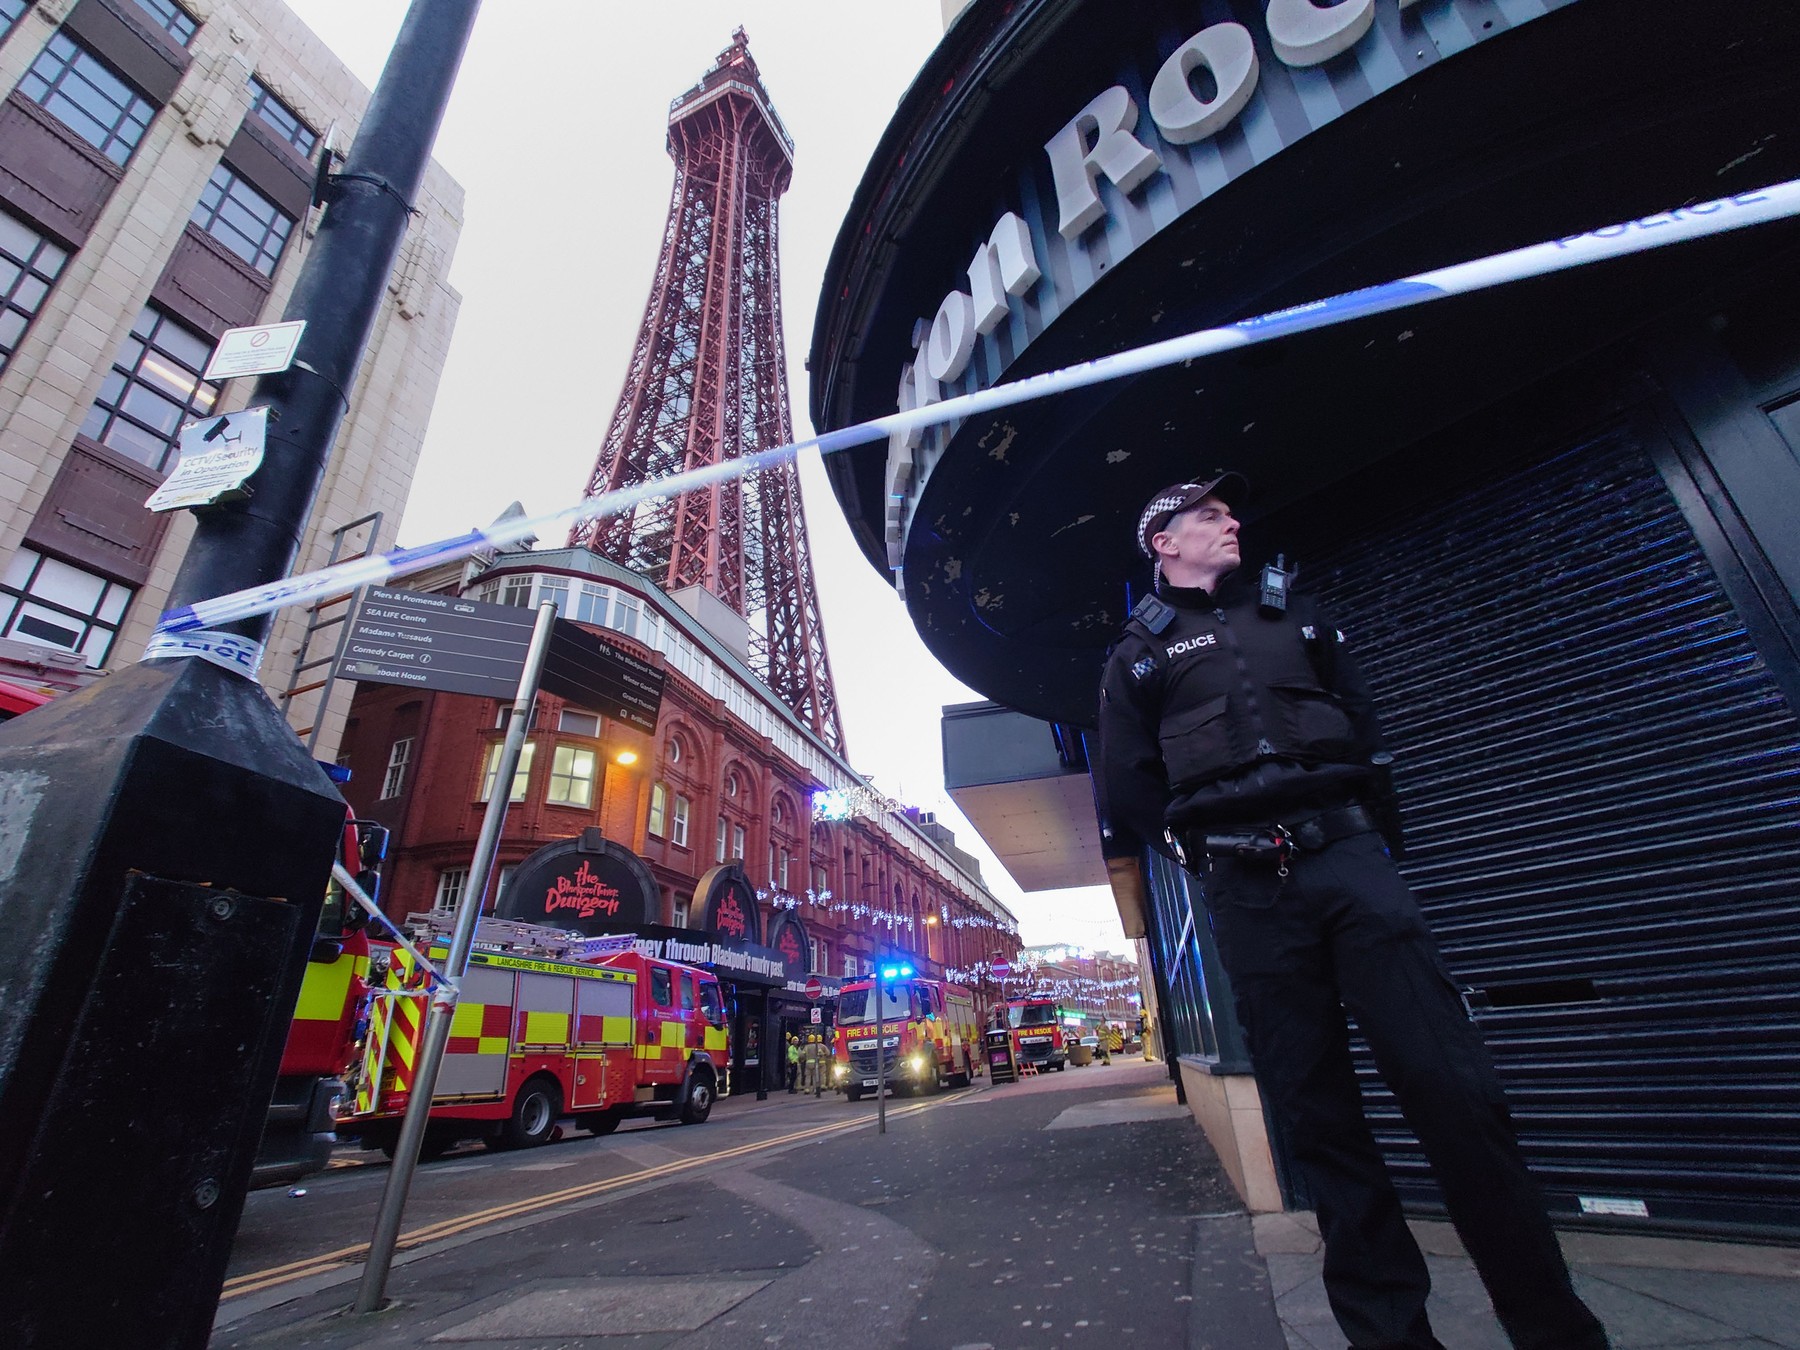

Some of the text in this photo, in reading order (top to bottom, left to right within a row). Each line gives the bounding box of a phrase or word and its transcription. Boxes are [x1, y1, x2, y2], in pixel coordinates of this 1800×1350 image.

[183, 447, 258, 468] CCTV/Security
[194, 460, 250, 474] Operation
[373, 590, 447, 608] Piers & Promenade
[366, 608, 427, 624] SEA LIFE Centre
[359, 627, 433, 643] Madame Tussauds
[352, 645, 415, 660] Comedy Carpet
[1166, 634, 1217, 659] POLICE
[400, 671, 427, 681] House
[648, 668, 663, 680] Tower
[639, 682, 660, 696] Gardens
[622, 692, 638, 704] Grand
[574, 860, 599, 885] the
[545, 887, 620, 918] Dungeon
[665, 937, 711, 963] through
[711, 943, 751, 972] Blackpool's
[750, 956, 770, 978] murky
[496, 957, 595, 977] LANCASHIRE FIRE & RESCUE SERVICE
[846, 1028, 861, 1038] FIRE
[863, 1027, 868, 1036] &
[1018, 1029, 1028, 1037] FIRE
[1033, 1027, 1053, 1036] RESCUE
